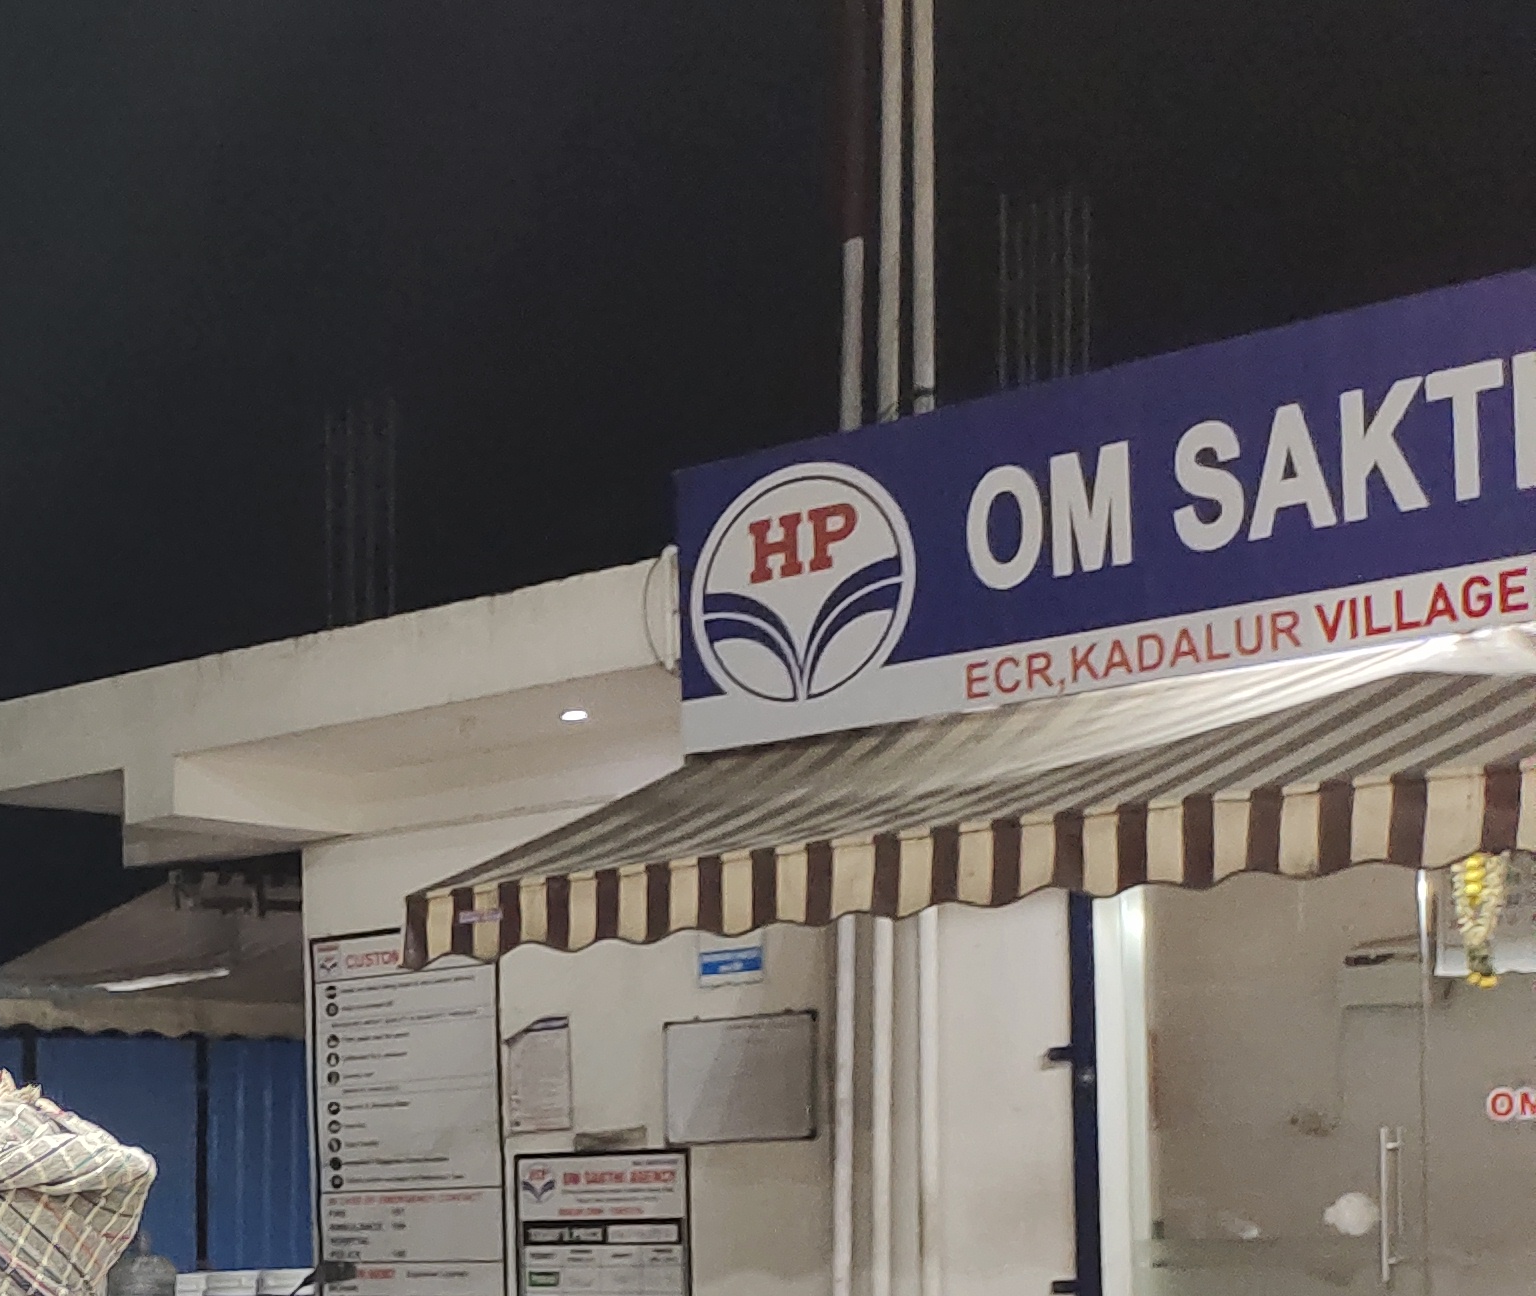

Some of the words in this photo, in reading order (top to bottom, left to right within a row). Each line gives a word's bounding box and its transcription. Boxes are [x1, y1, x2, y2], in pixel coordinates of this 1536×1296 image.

[748, 503, 858, 585] HP
[966, 441, 1133, 590] OM
[1315, 567, 1529, 643] VILLAGE
